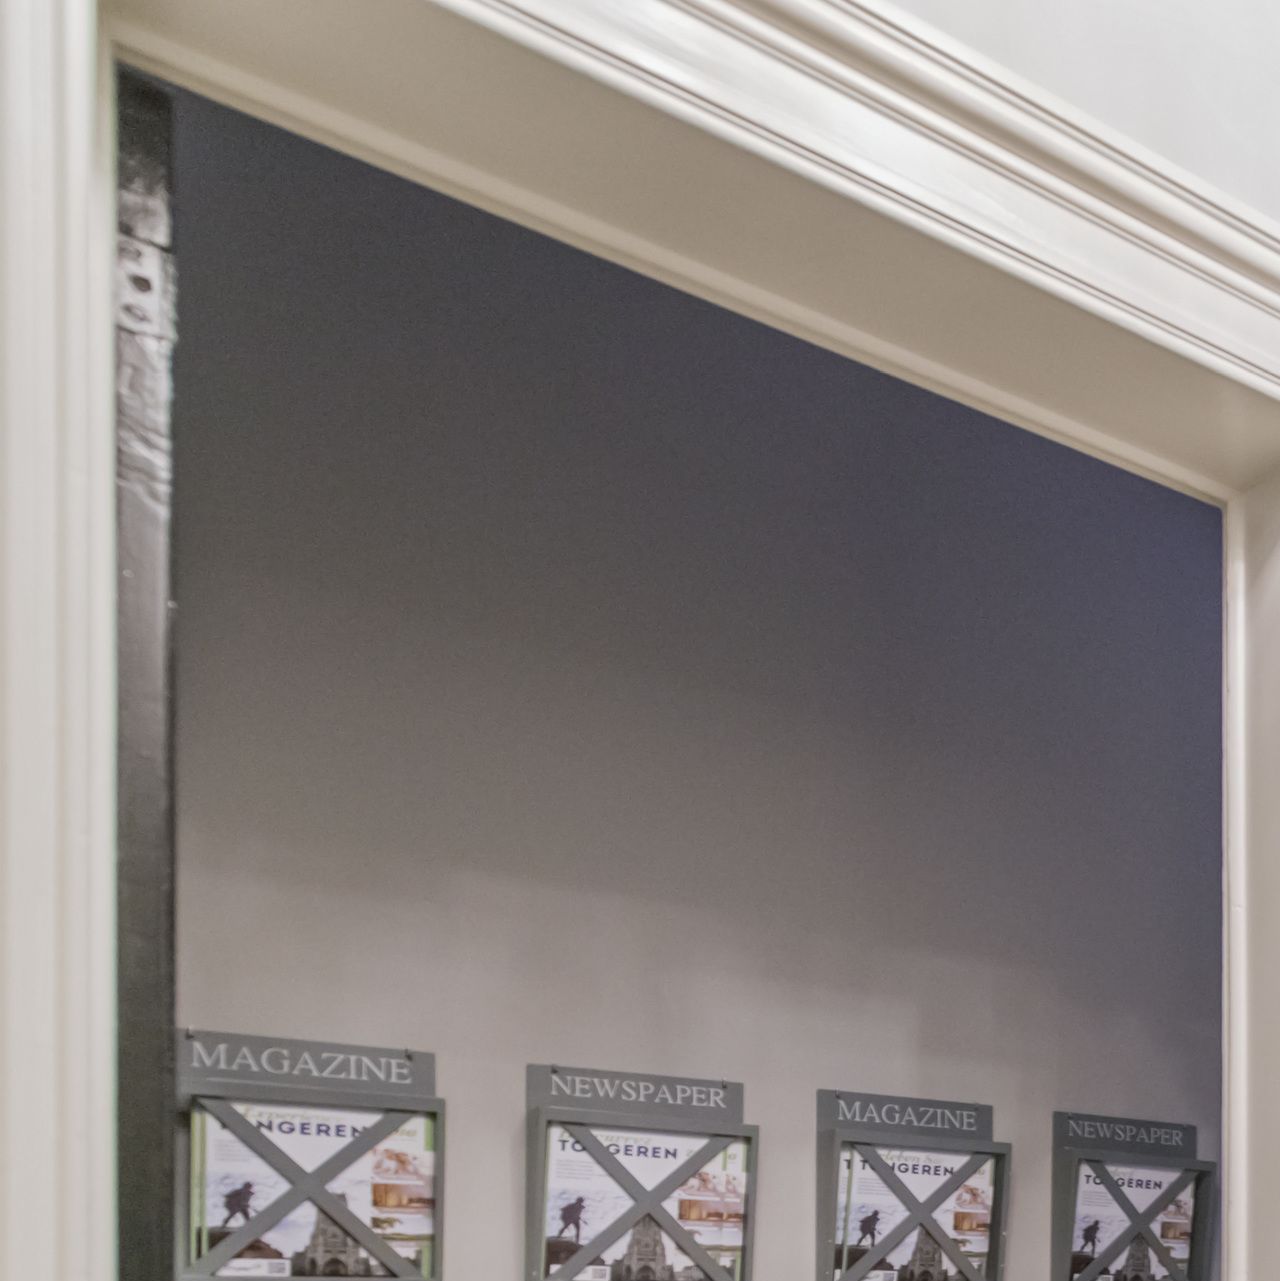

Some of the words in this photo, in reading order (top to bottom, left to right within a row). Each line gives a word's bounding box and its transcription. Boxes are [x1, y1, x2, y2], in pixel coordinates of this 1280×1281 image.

[190, 1040, 413, 1085] MAGAZINE
[550, 1074, 727, 1109] NEWSPAPER
[837, 1099, 978, 1131] MAGAZINE
[1067, 1119, 1185, 1146] NEWSPAPER
[557, 1138, 679, 1161] TOGEREN
[1084, 1173, 1163, 1190] TOGEREN
